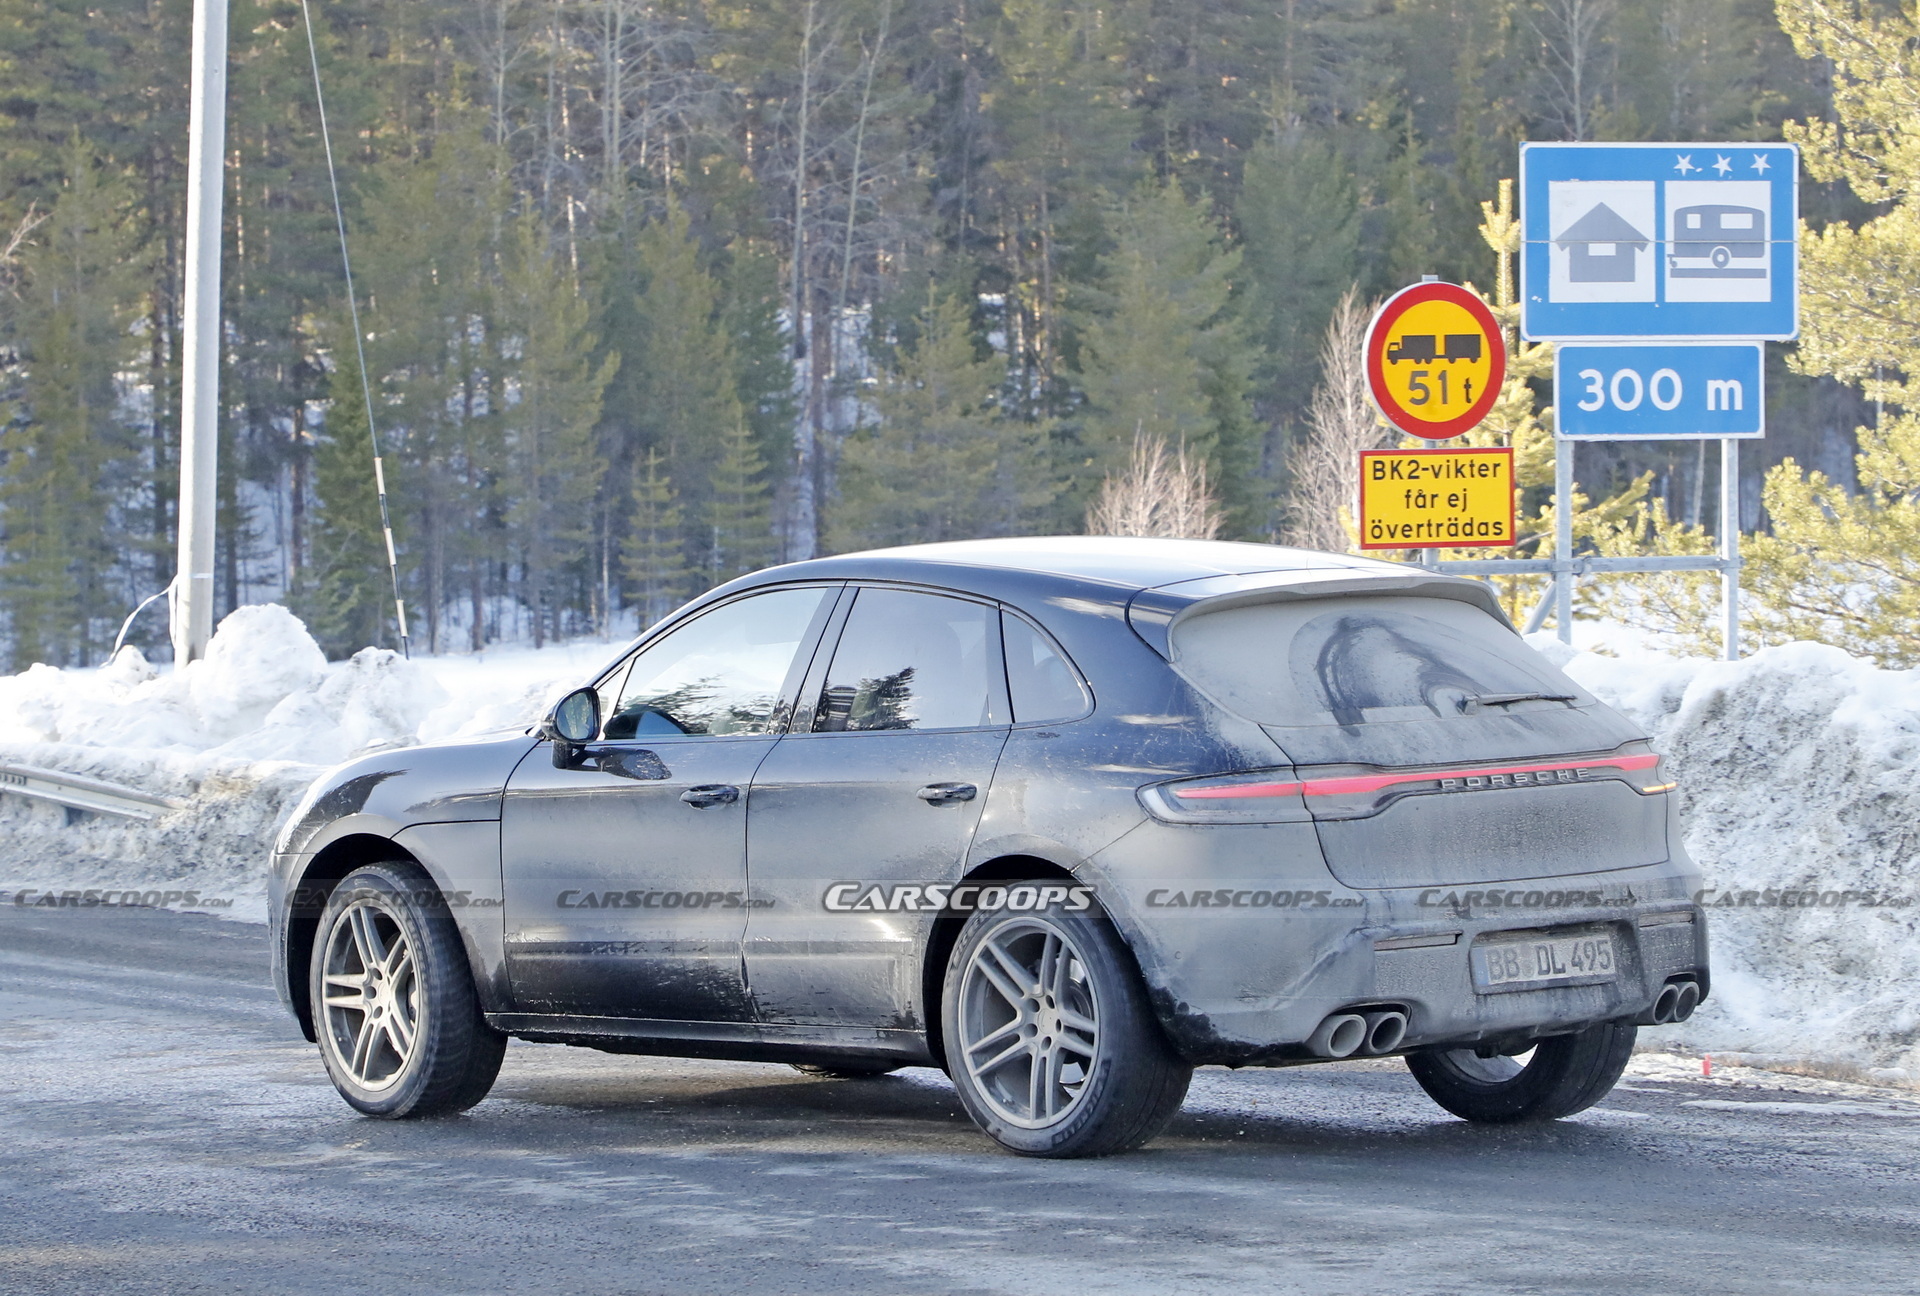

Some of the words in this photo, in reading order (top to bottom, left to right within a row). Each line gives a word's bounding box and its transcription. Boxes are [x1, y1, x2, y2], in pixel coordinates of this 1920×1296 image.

[1408, 370, 1449, 406] 51
[1463, 377, 1473, 404] t
[1577, 368, 1683, 412] 300
[1706, 378, 1744, 411] m
[1372, 458, 1502, 481] BK2-vikter
[1404, 488, 1440, 510] får
[1446, 491, 1468, 512] ej
[1371, 517, 1504, 541] överträdas
[1440, 767, 1590, 789] PORSCHE
[1488, 949, 1521, 981] BB
[1534, 944, 1567, 976] DL
[1571, 940, 1612, 972] 495
